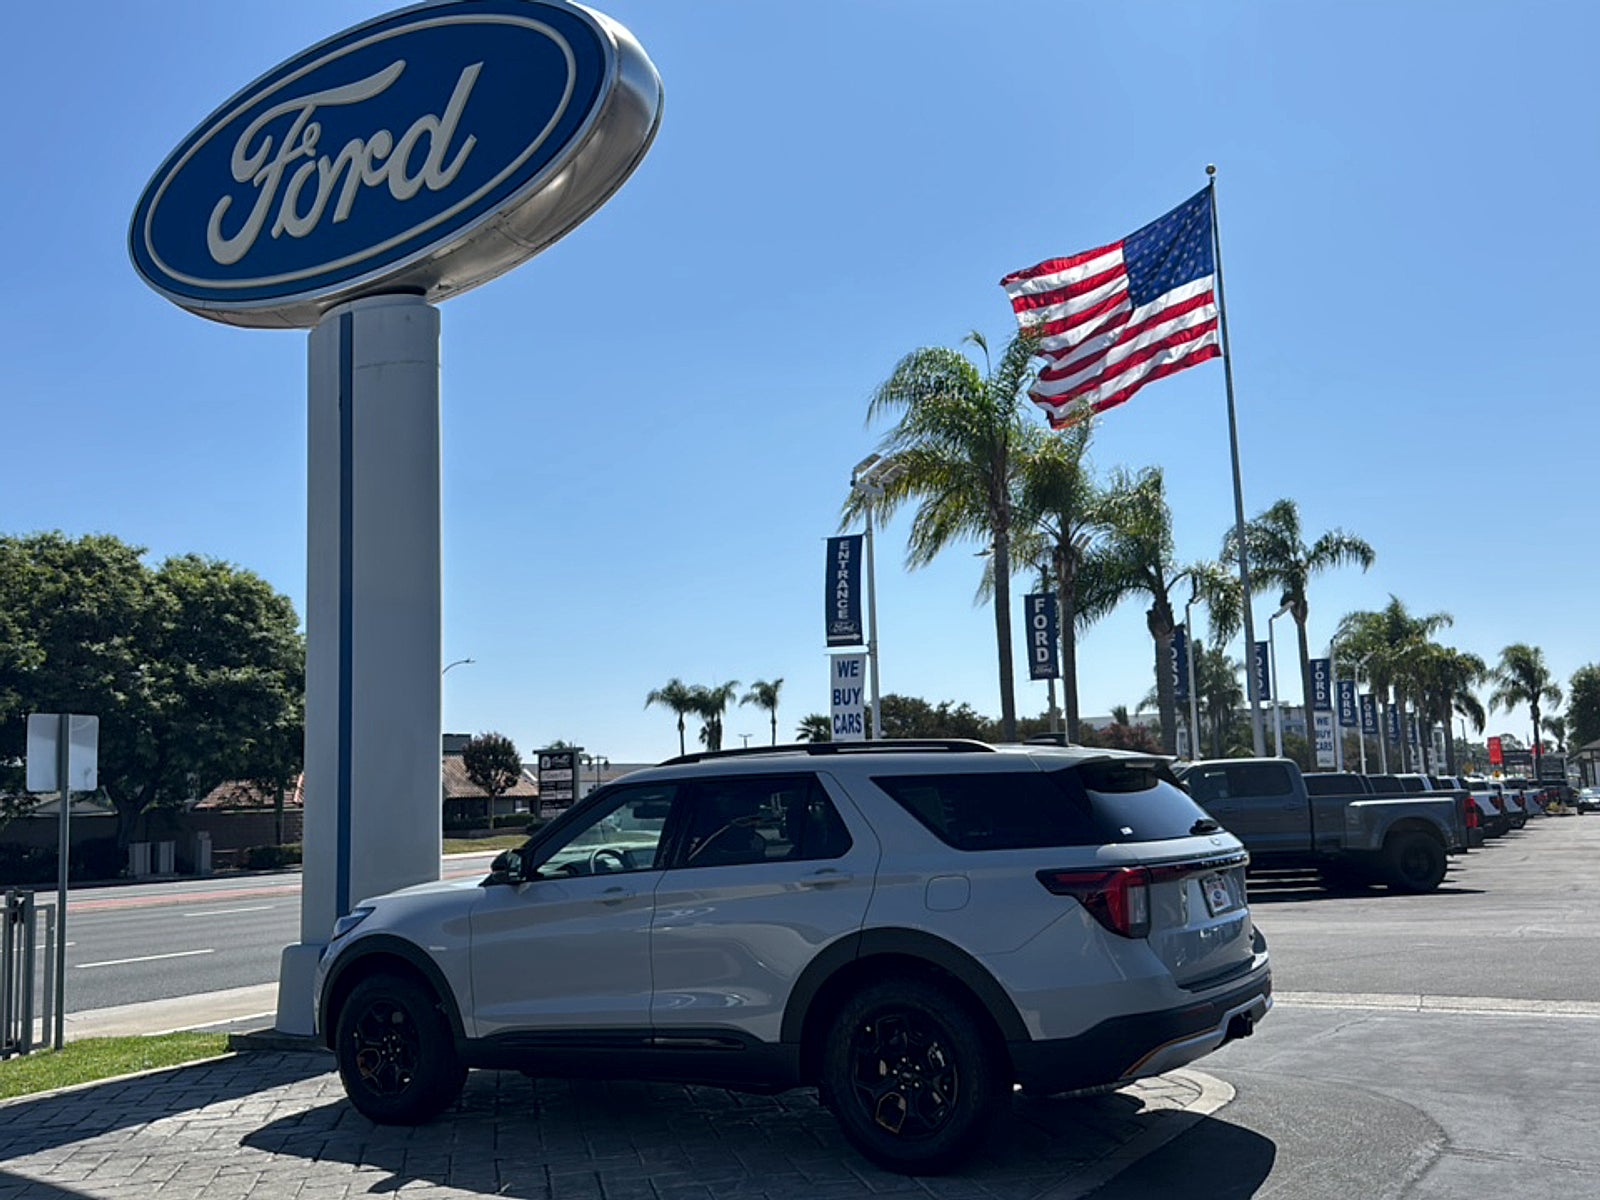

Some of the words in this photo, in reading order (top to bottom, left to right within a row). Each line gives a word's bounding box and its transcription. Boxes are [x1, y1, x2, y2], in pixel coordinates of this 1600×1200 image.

[207, 59, 484, 266] Ford
[836, 540, 850, 620] ENTRANCE
[1033, 598, 1050, 663] FORD
[837, 660, 860, 678] WE
[1315, 661, 1325, 701] FORD
[833, 687, 861, 706] BUY
[1341, 683, 1351, 717] FORD
[833, 713, 862, 734] CARS
